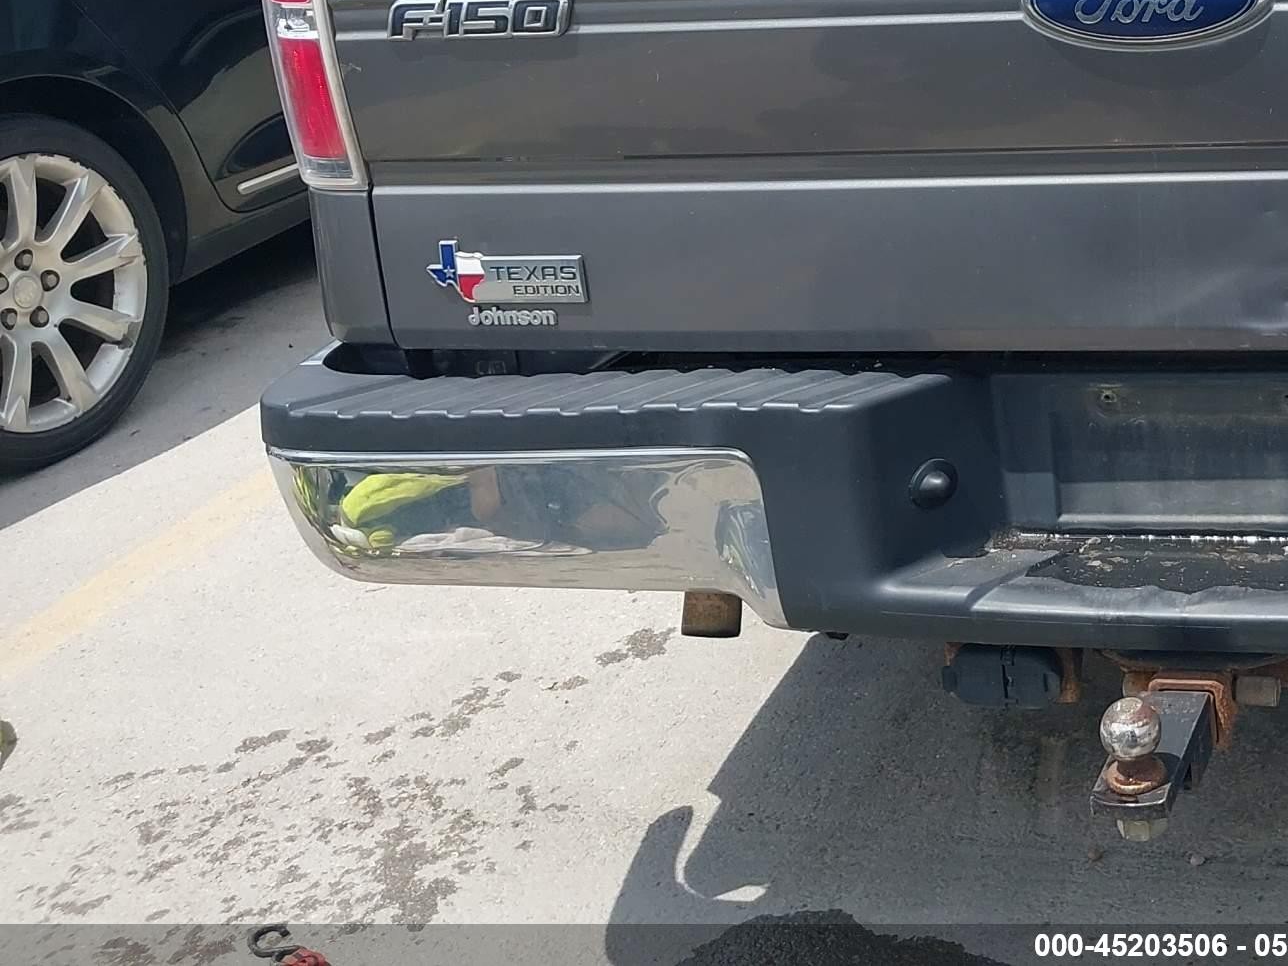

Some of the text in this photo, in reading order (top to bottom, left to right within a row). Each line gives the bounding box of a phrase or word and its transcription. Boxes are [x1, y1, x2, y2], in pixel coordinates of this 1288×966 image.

[490, 265, 577, 282] TEXAS
[513, 284, 580, 295] EDITION
[467, 306, 557, 327] Johnson
